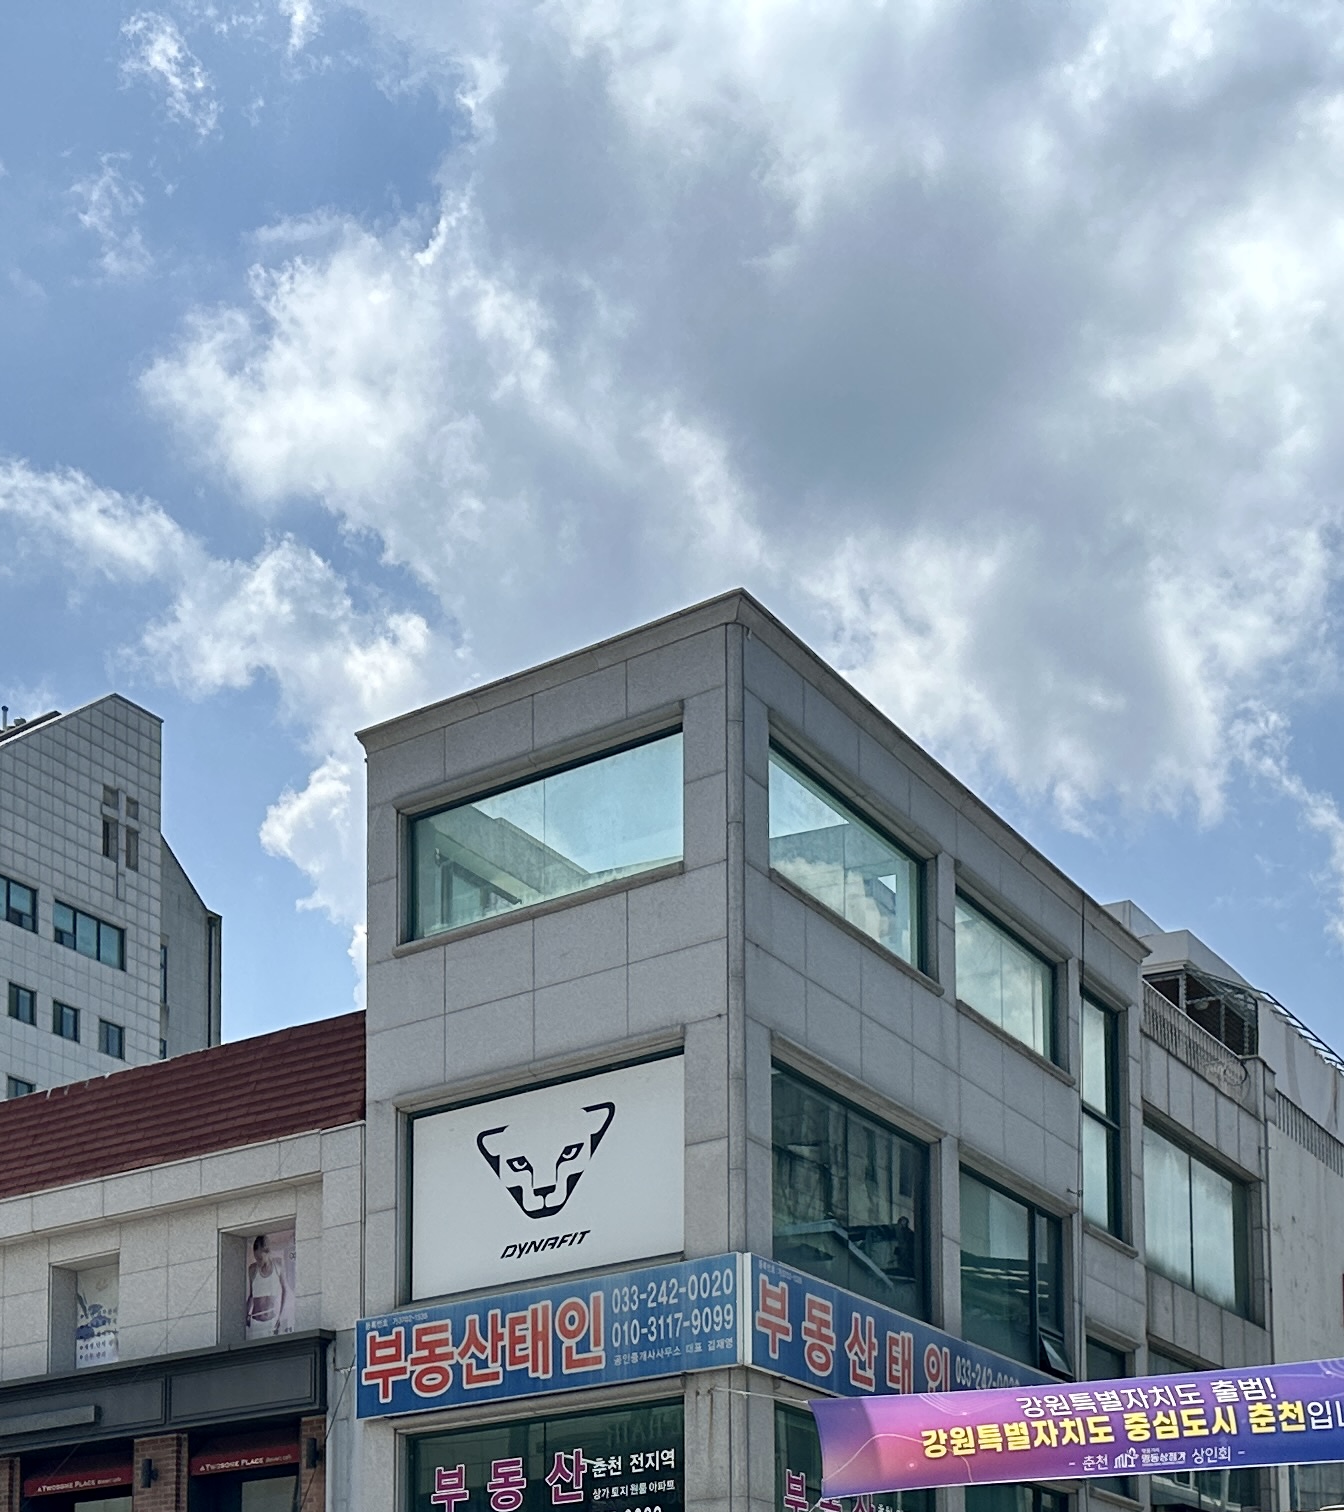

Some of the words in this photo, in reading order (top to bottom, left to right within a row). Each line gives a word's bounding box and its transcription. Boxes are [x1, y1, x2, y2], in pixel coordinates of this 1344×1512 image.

[500, 1229, 591, 1260] DYNAFIT
[612, 1267, 734, 1314] 033-242-0020
[612, 1303, 734, 1348] 010-3117-9099
[360, 1290, 605, 1404] 부동산태인
[613, 1345, 682, 1368] 공인중개사사무소
[685, 1342, 703, 1356] 대표
[1016, 1384, 1205, 1419] 강원특별자치도
[1211, 1377, 1277, 1402] 출범!
[920, 1414, 1115, 1460] 강원특별자치도
[1122, 1404, 1238, 1443] 중심도시
[591, 1455, 622, 1479] 춘천
[629, 1448, 675, 1474] 전지역
[1082, 1453, 1109, 1471] 춘천
[1192, 1446, 1231, 1465] 상인회
[592, 1486, 610, 1501] 상가
[648, 1479, 676, 1493] 아파트
